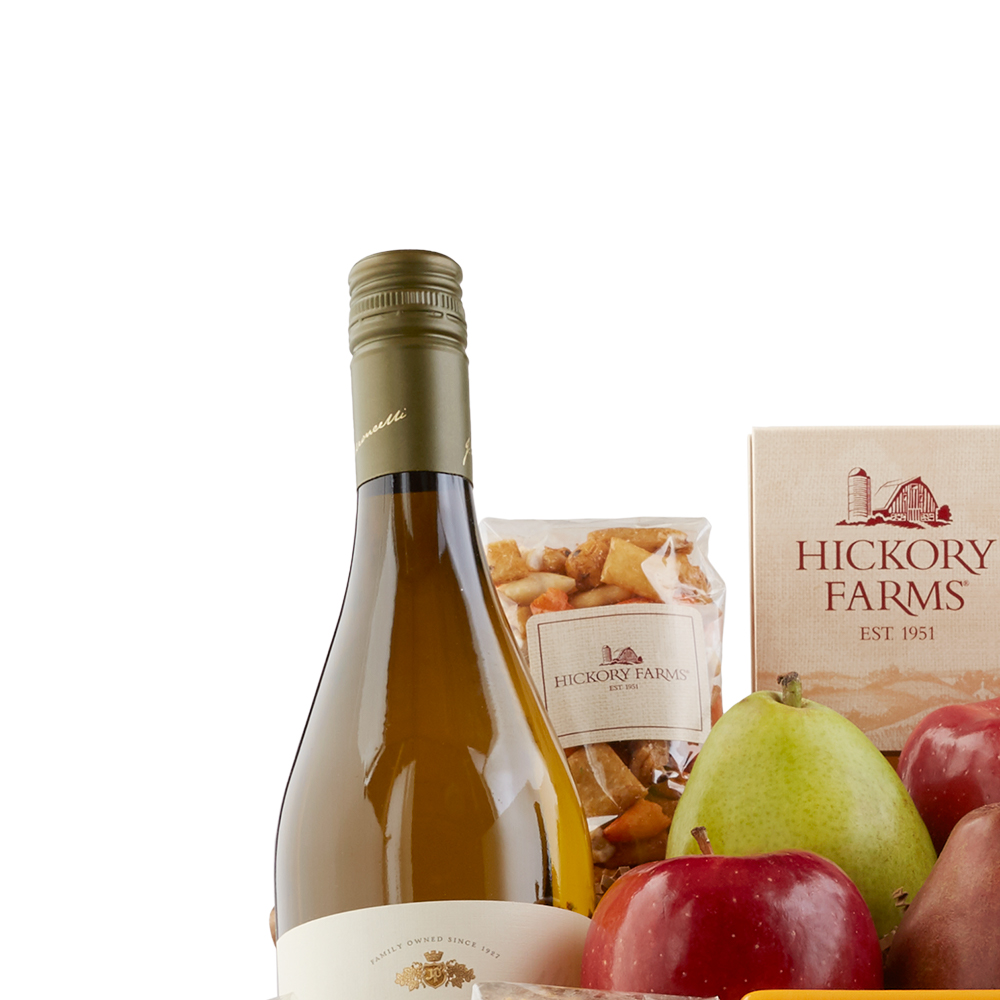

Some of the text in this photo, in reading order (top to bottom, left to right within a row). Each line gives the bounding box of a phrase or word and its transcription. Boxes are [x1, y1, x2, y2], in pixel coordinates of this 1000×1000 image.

[796, 539, 997, 575] HICKORY
[902, 626, 936, 641] 1951
[554, 668, 631, 688] HICKORY
[625, 683, 639, 691] 1951
[370, 936, 501, 965] FAMILY OWNED SINCE 1927
